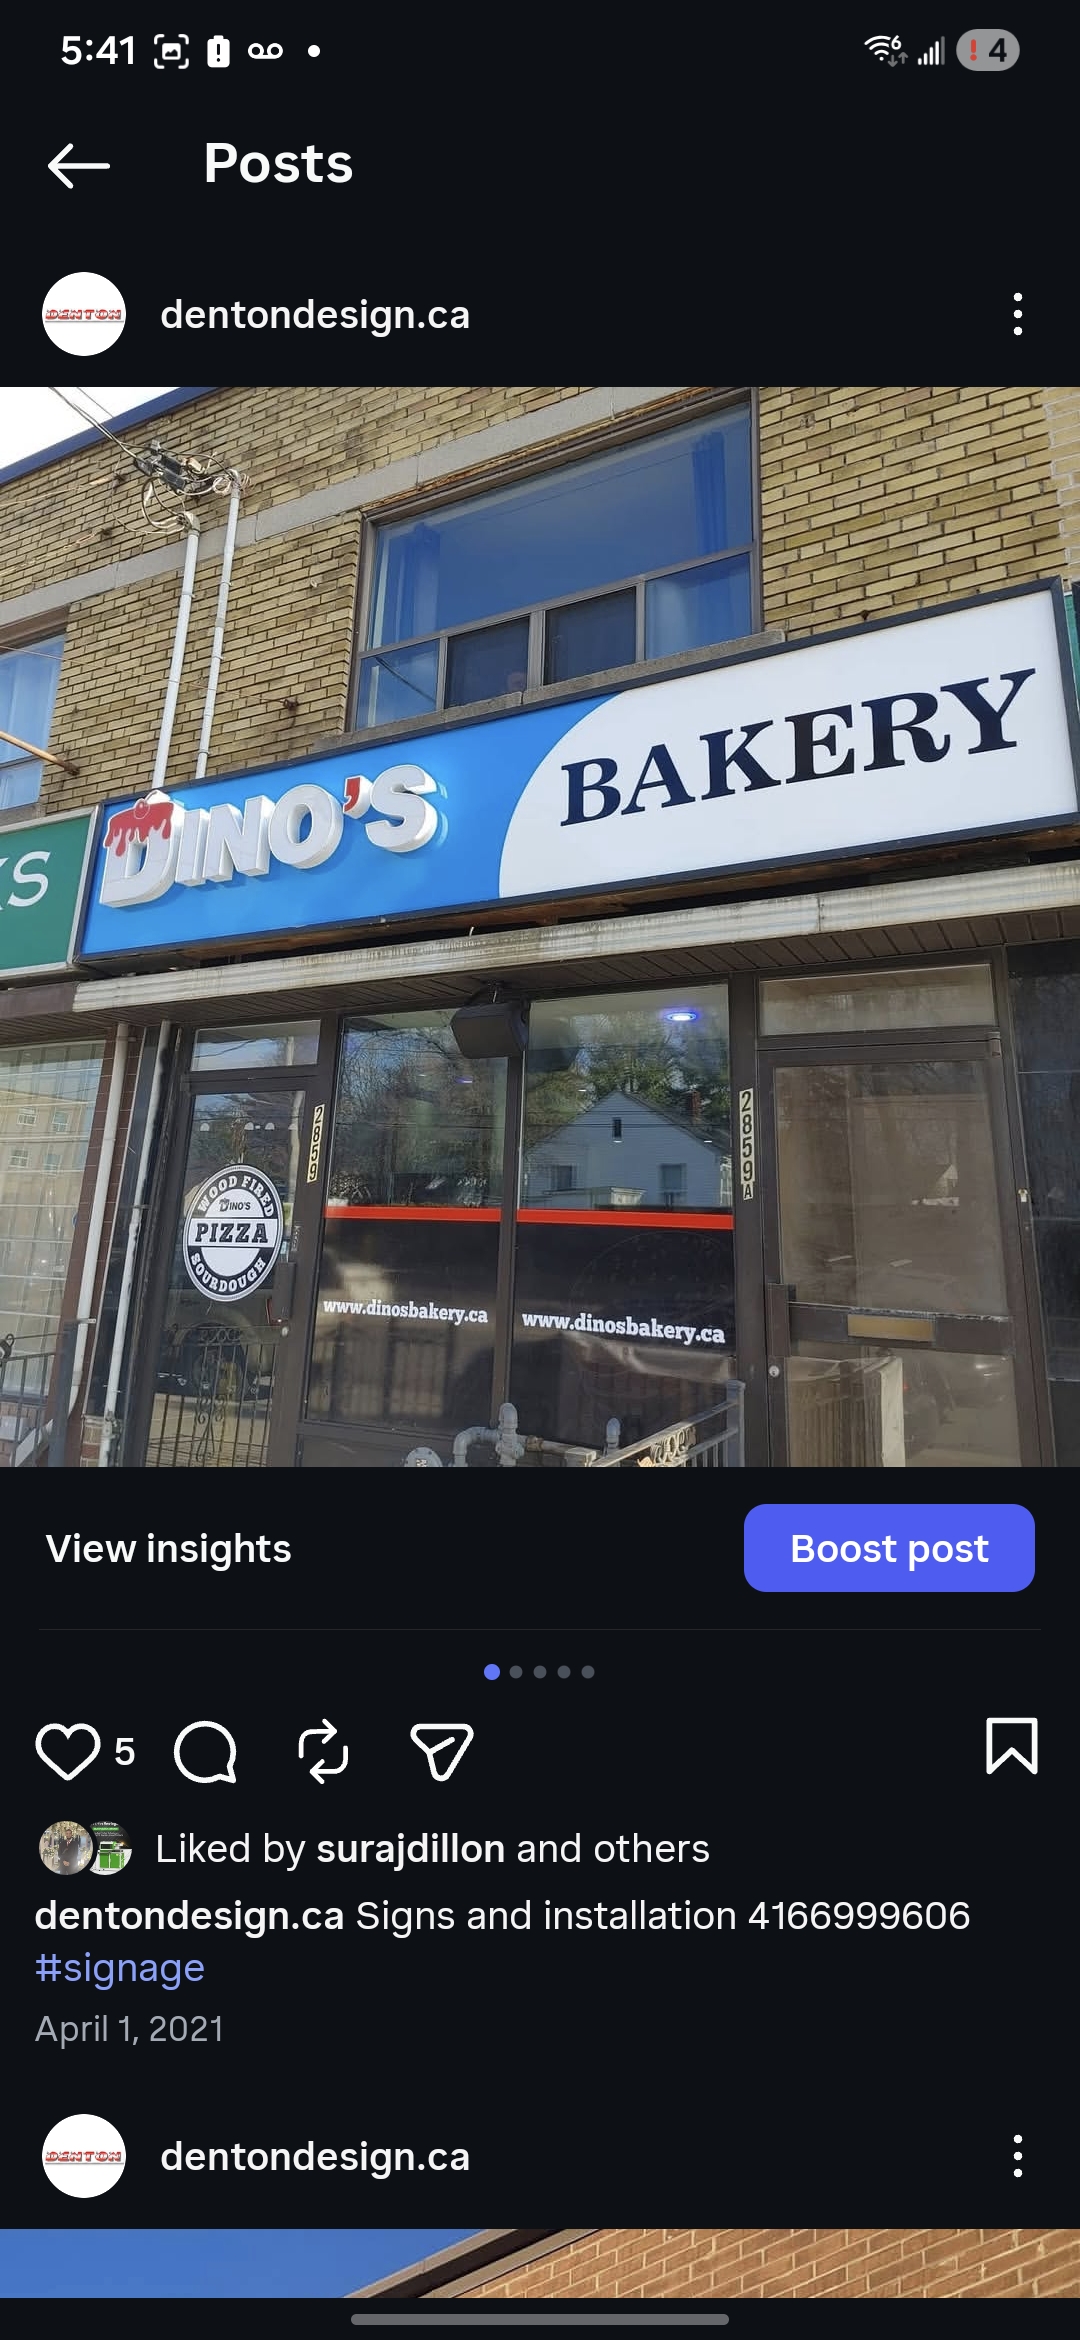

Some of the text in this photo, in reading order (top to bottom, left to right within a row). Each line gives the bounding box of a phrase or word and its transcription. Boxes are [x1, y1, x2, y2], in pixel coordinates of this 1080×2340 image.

[560, 667, 1036, 827] BAKERY
[99, 764, 440, 908] DINO'S
[308, 1106, 323, 1181] 2859
[197, 1175, 274, 1217] WOOD FIRED
[194, 1222, 268, 1243] PIZZA
[190, 1252, 266, 1292] SOURDOUGH
[323, 1298, 488, 1326] www.dinosbakery.ca
[521, 1310, 726, 1345] www.dinosbakery.ca
